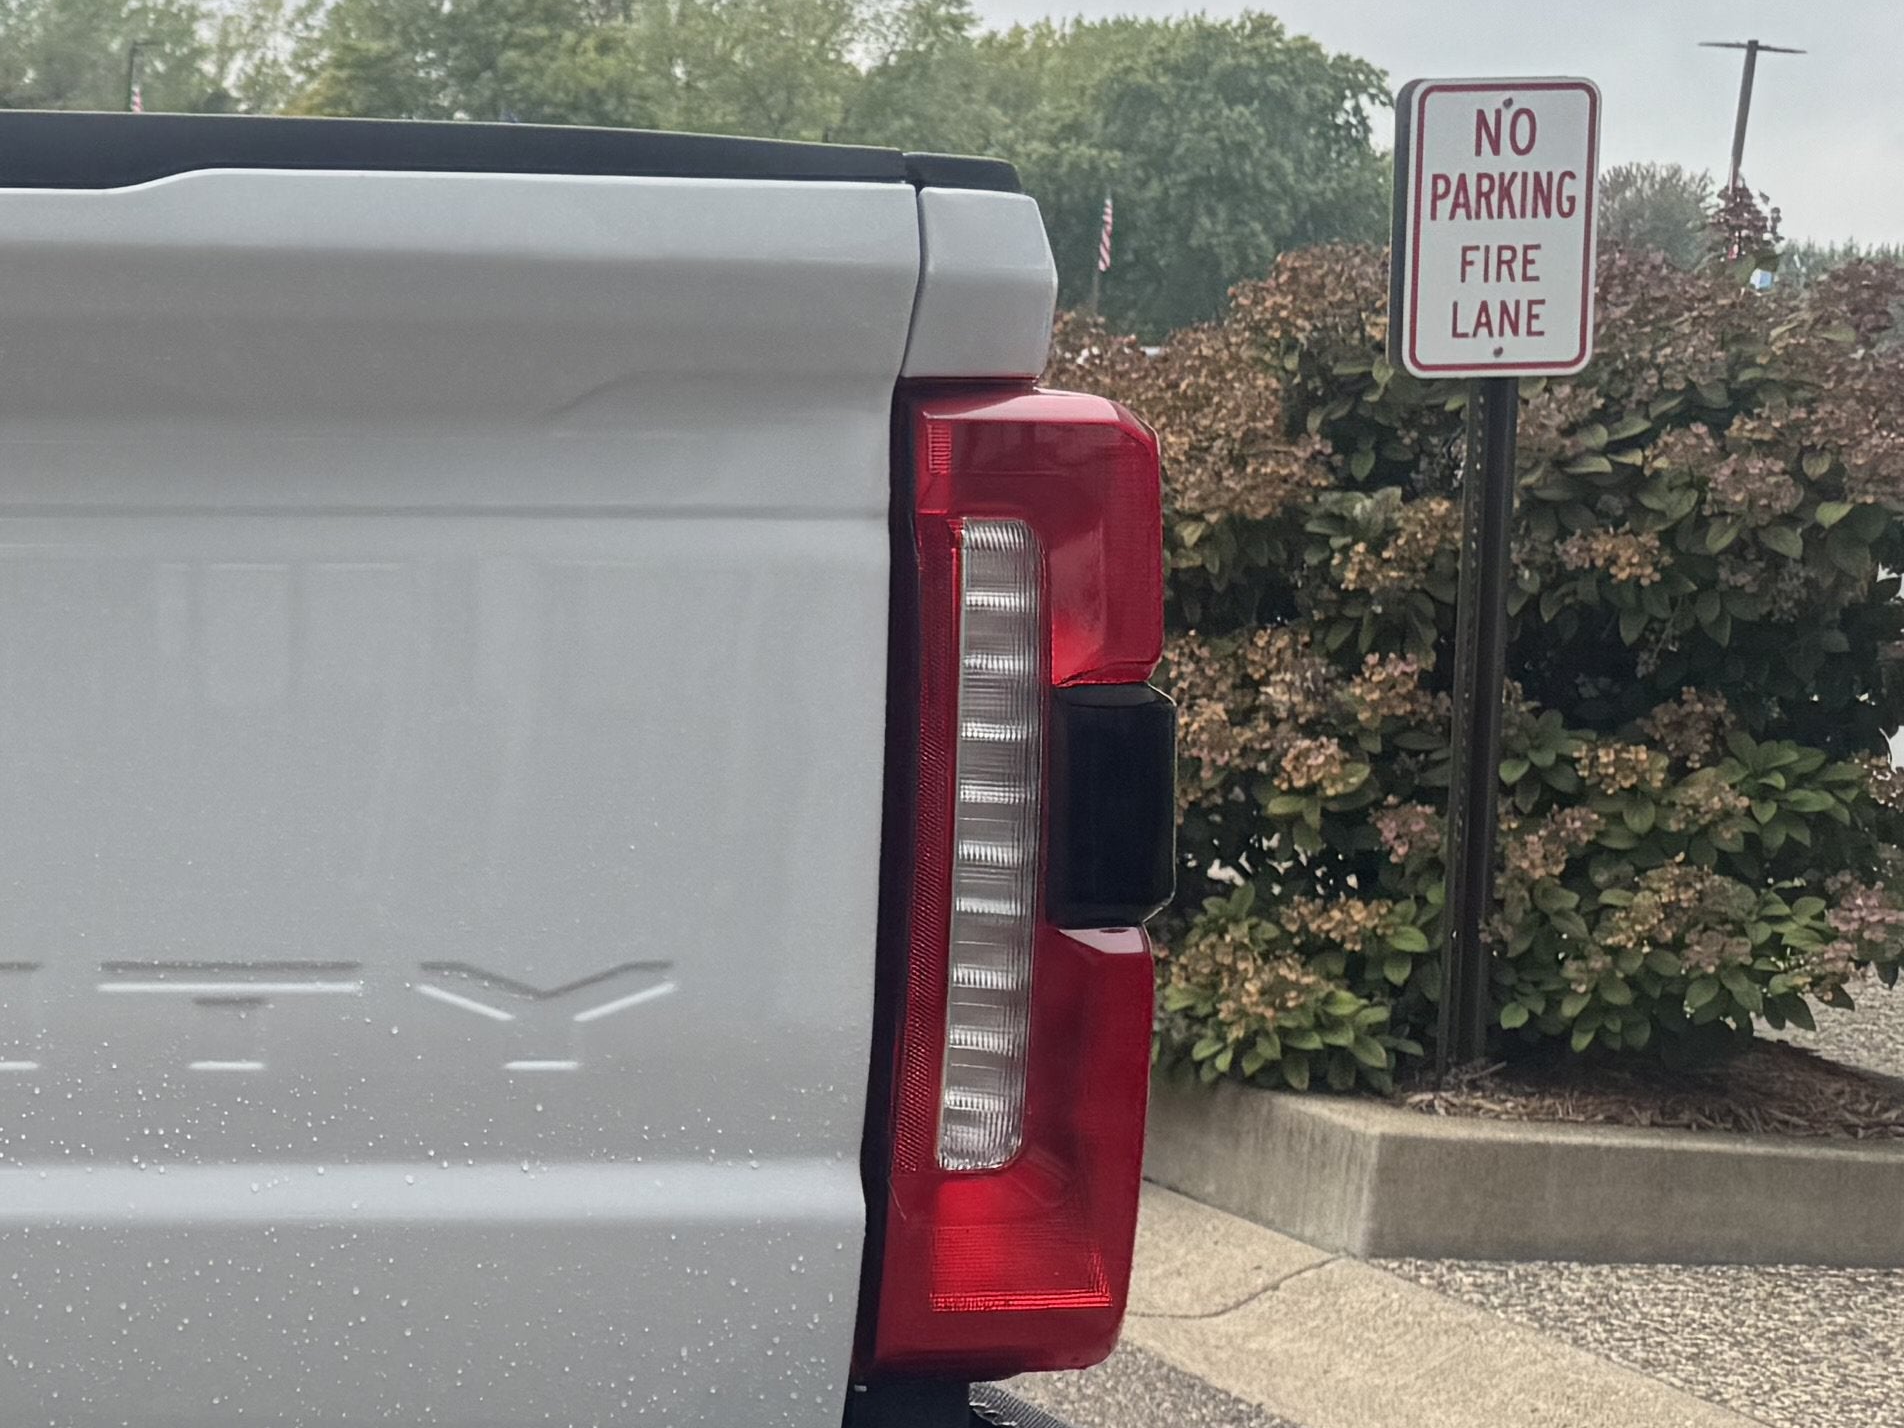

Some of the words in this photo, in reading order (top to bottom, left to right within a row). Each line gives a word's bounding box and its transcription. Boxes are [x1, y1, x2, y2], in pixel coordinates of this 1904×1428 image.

[1474, 107, 1537, 157] NO
[1430, 170, 1577, 221] PARKING
[1460, 244, 1542, 283] FIRE
[1451, 299, 1546, 339] LANE
